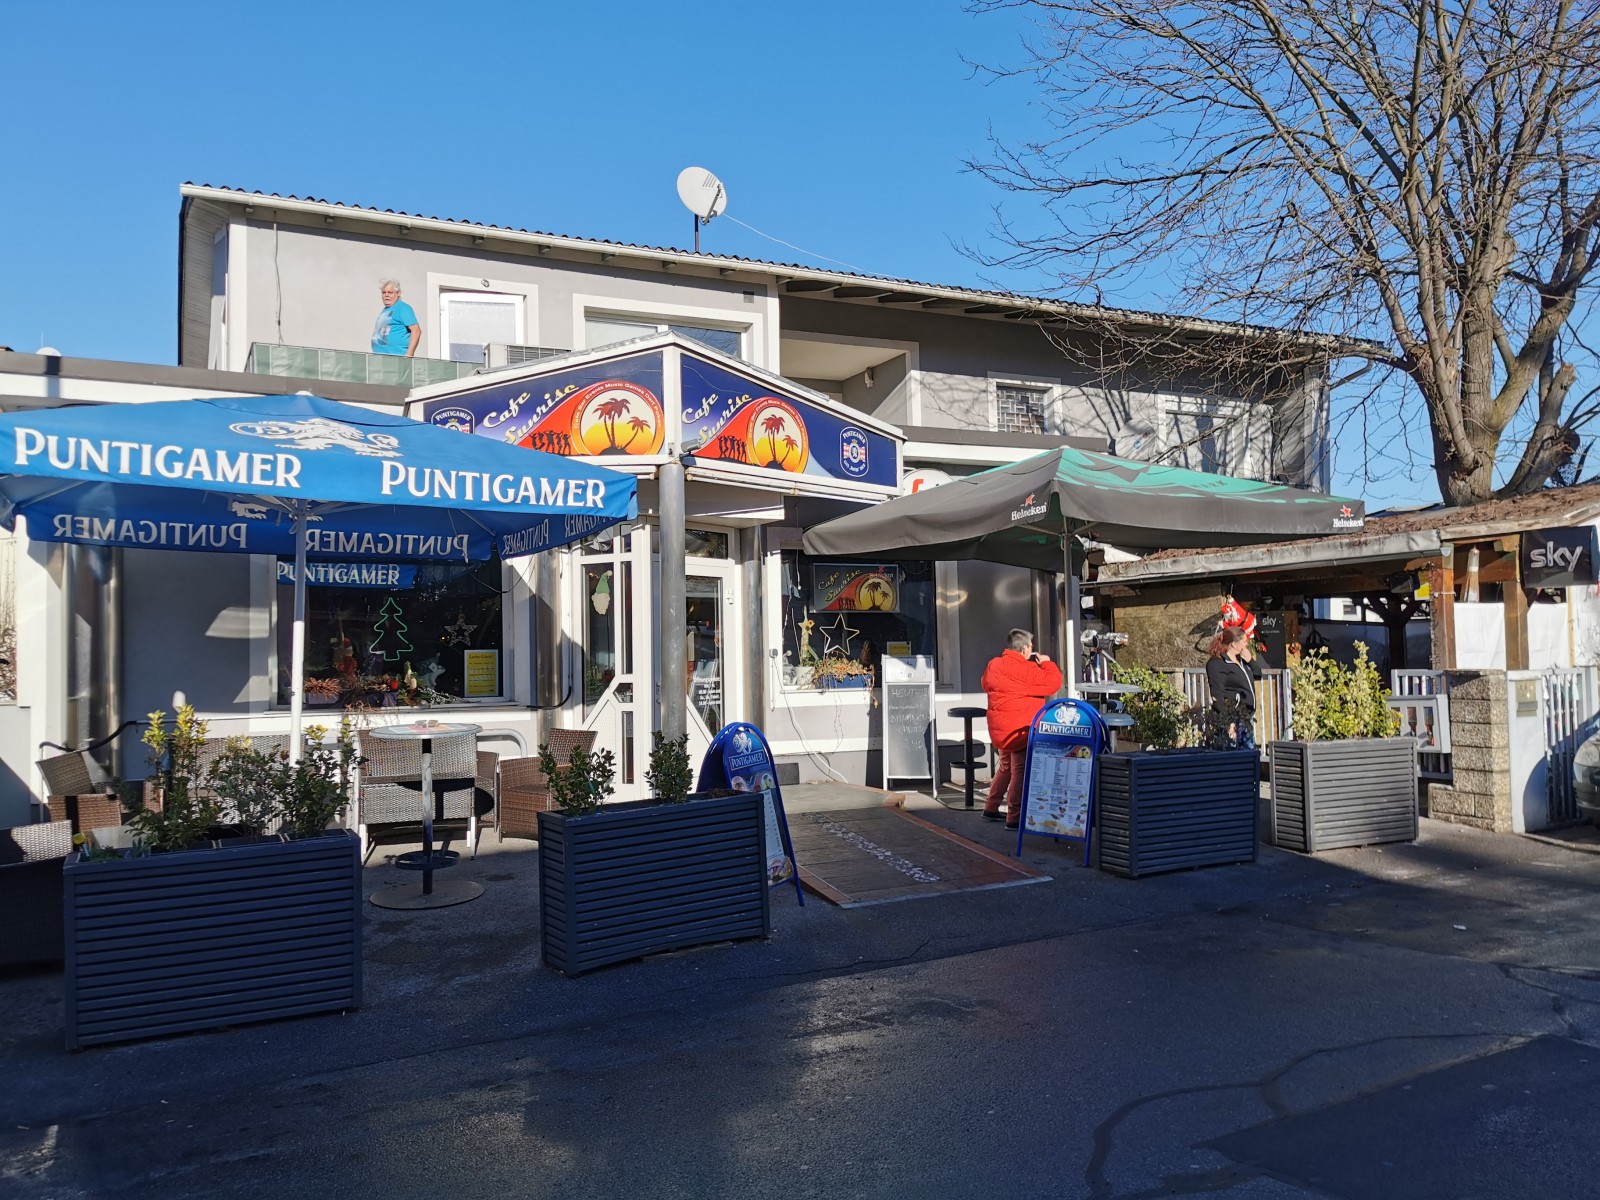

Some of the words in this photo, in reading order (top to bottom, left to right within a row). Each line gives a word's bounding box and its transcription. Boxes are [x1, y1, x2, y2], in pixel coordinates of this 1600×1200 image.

[435, 410, 472, 421] PUNTIGAMER
[483, 392, 531, 428] Cafe
[504, 385, 580, 445] Sunrise
[681, 393, 719, 424] Cafe
[698, 394, 752, 445] Sunrise
[14, 426, 302, 489] PUNTIGAMER
[381, 460, 605, 508] PUNTIGAMER
[1011, 505, 1047, 520] Heineken
[1333, 517, 1364, 528] Heineken
[1530, 540, 1584, 573] sky
[1262, 615, 1277, 628] sky
[1042, 724, 1090, 736] PUNTIGAMER
[730, 752, 764, 768] PUNTIGAMER
